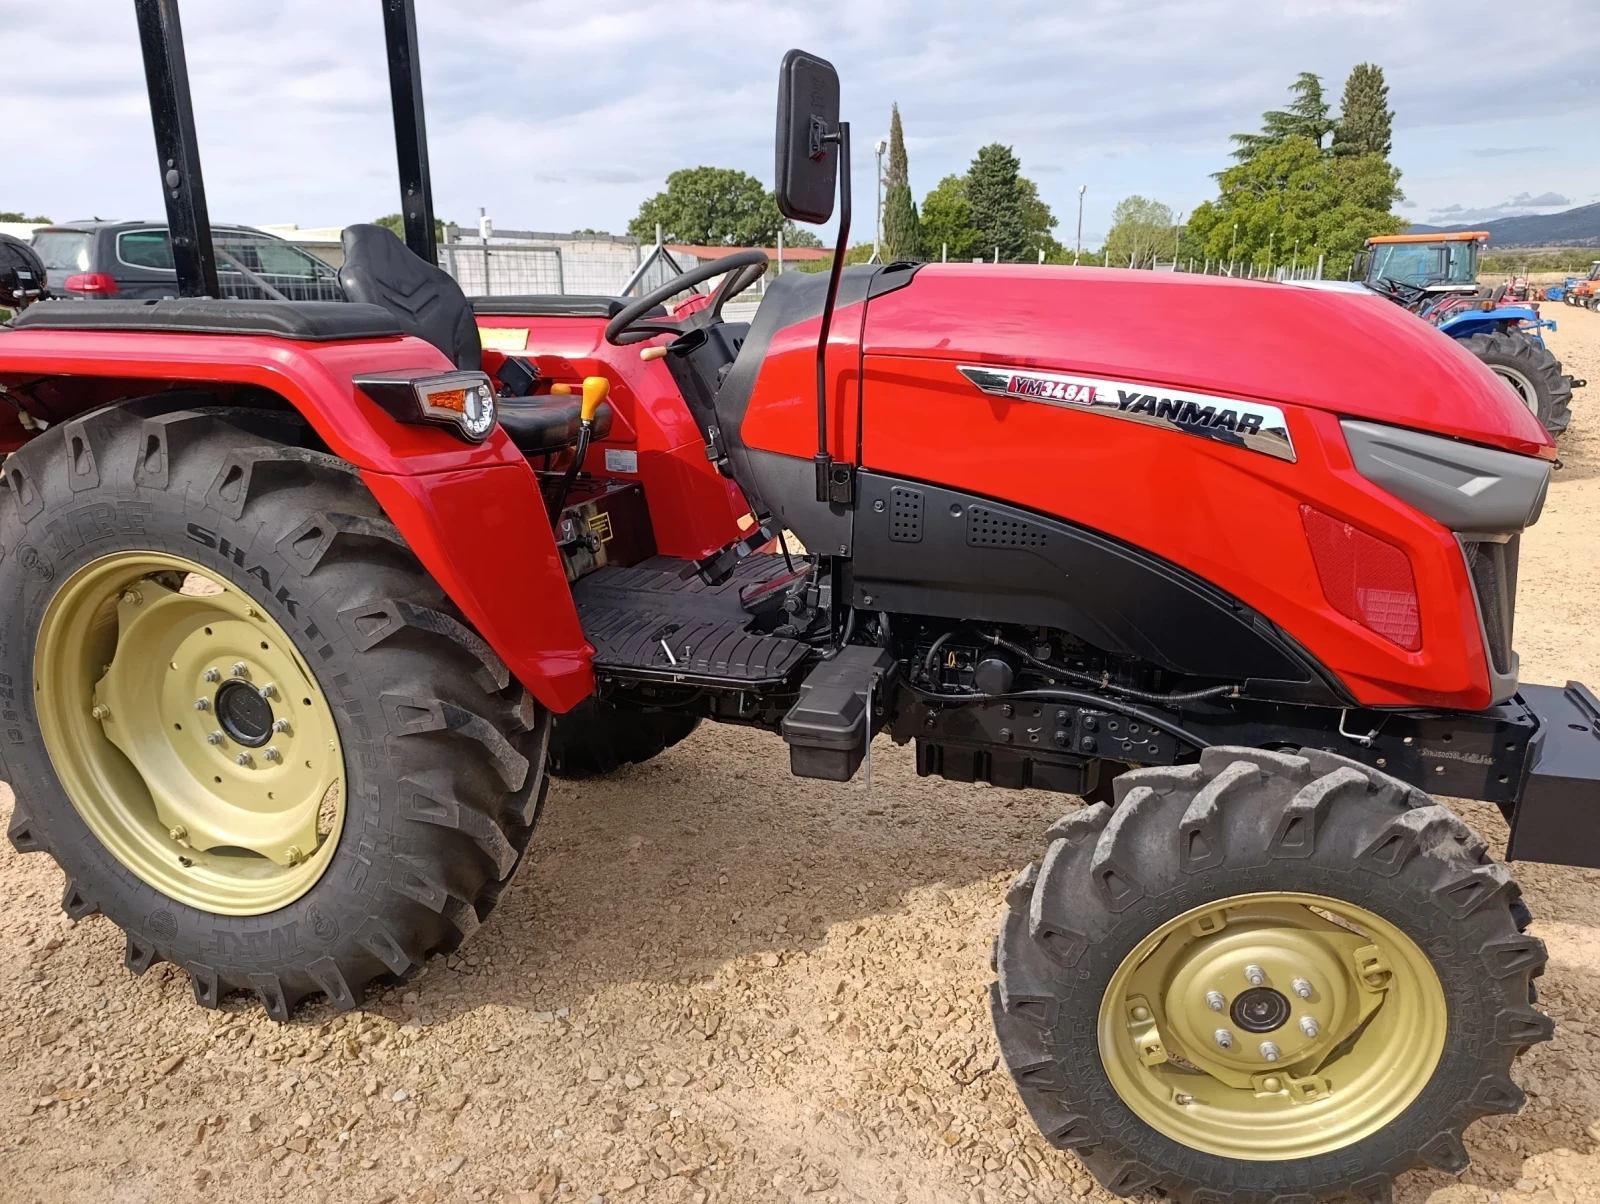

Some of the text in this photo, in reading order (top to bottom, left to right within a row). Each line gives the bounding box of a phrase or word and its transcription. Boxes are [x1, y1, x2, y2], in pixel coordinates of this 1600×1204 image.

[1013, 376, 1091, 405] YM348A
[1116, 389, 1265, 436] YANMAR
[44, 500, 152, 560] MRF
[186, 522, 335, 662] SHAKTI
[350, 781, 381, 895] PLUS
[199, 920, 305, 963] MRF
